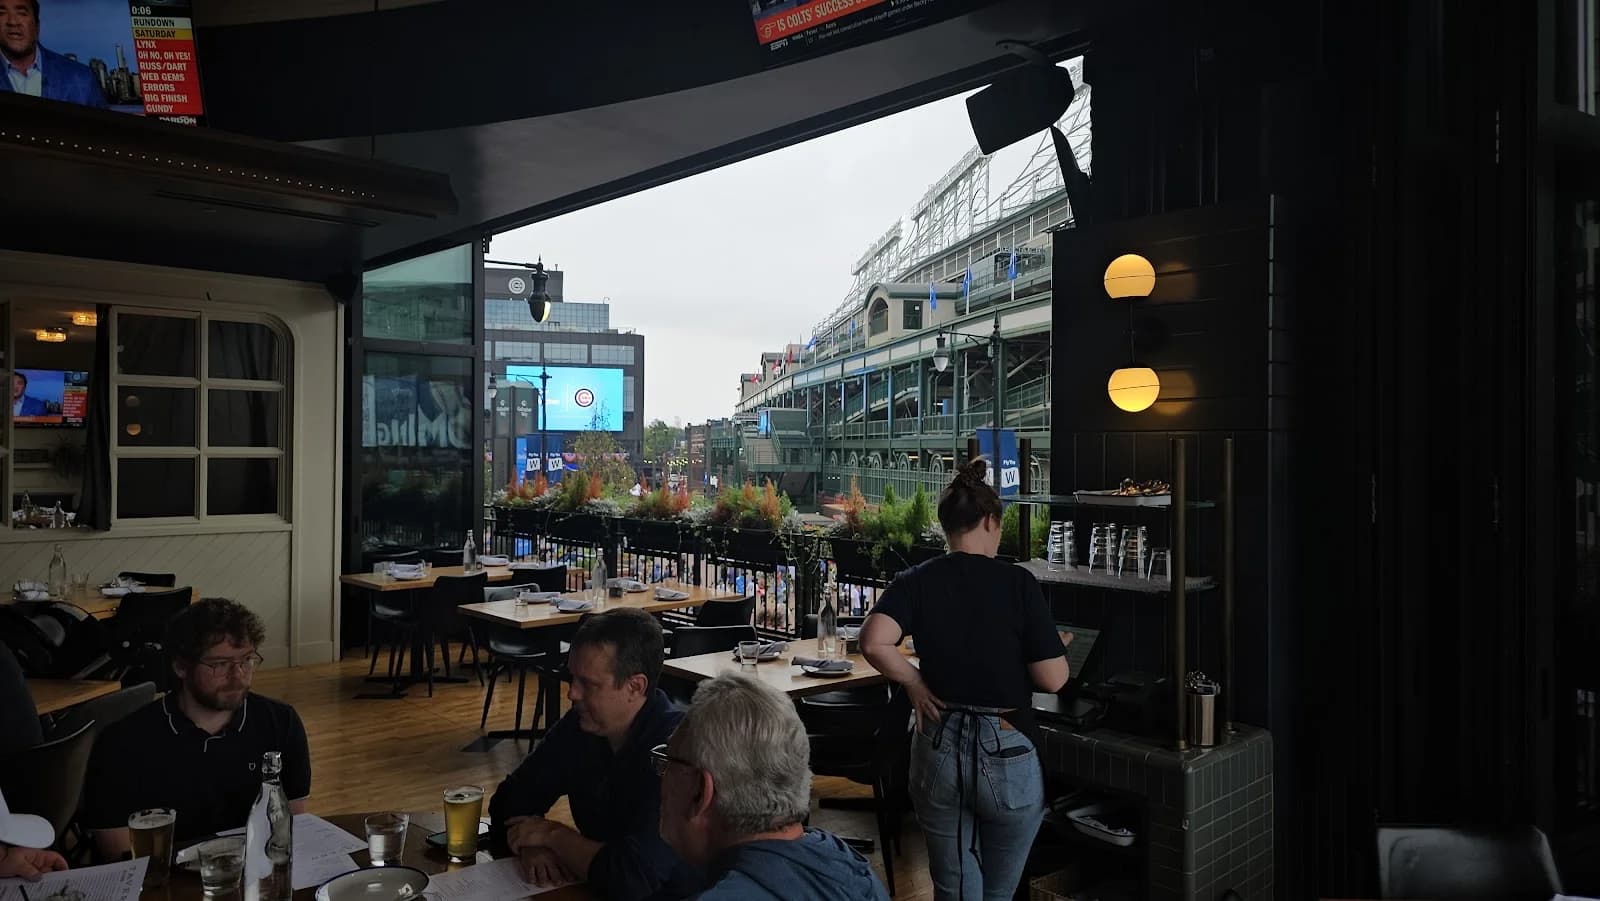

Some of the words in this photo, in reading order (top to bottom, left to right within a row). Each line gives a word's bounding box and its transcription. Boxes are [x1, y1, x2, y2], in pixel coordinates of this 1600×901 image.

[131, 6, 152, 15] 0:06
[777, 19, 786, 32] IS
[815, 0, 856, 18] SUCCESS
[133, 18, 175, 27] RUNDOWN
[135, 29, 176, 38] SATURDAY
[136, 39, 157, 49] LYNX
[769, 38, 789, 51] ESPN
[137, 51, 149, 60] OH
[163, 51, 175, 60] OH
[175, 51, 191, 61] YES!
[141, 73, 160, 81] WEB
[161, 73, 185, 82] GEMS
[143, 83, 176, 92] ERRORS
[144, 94, 159, 103] BIG
[161, 94, 188, 103] FINISH
[146, 104, 174, 113] GUNDY
[529, 459, 538, 469] W
[551, 459, 560, 469] W
[1005, 471, 1016, 484] W
